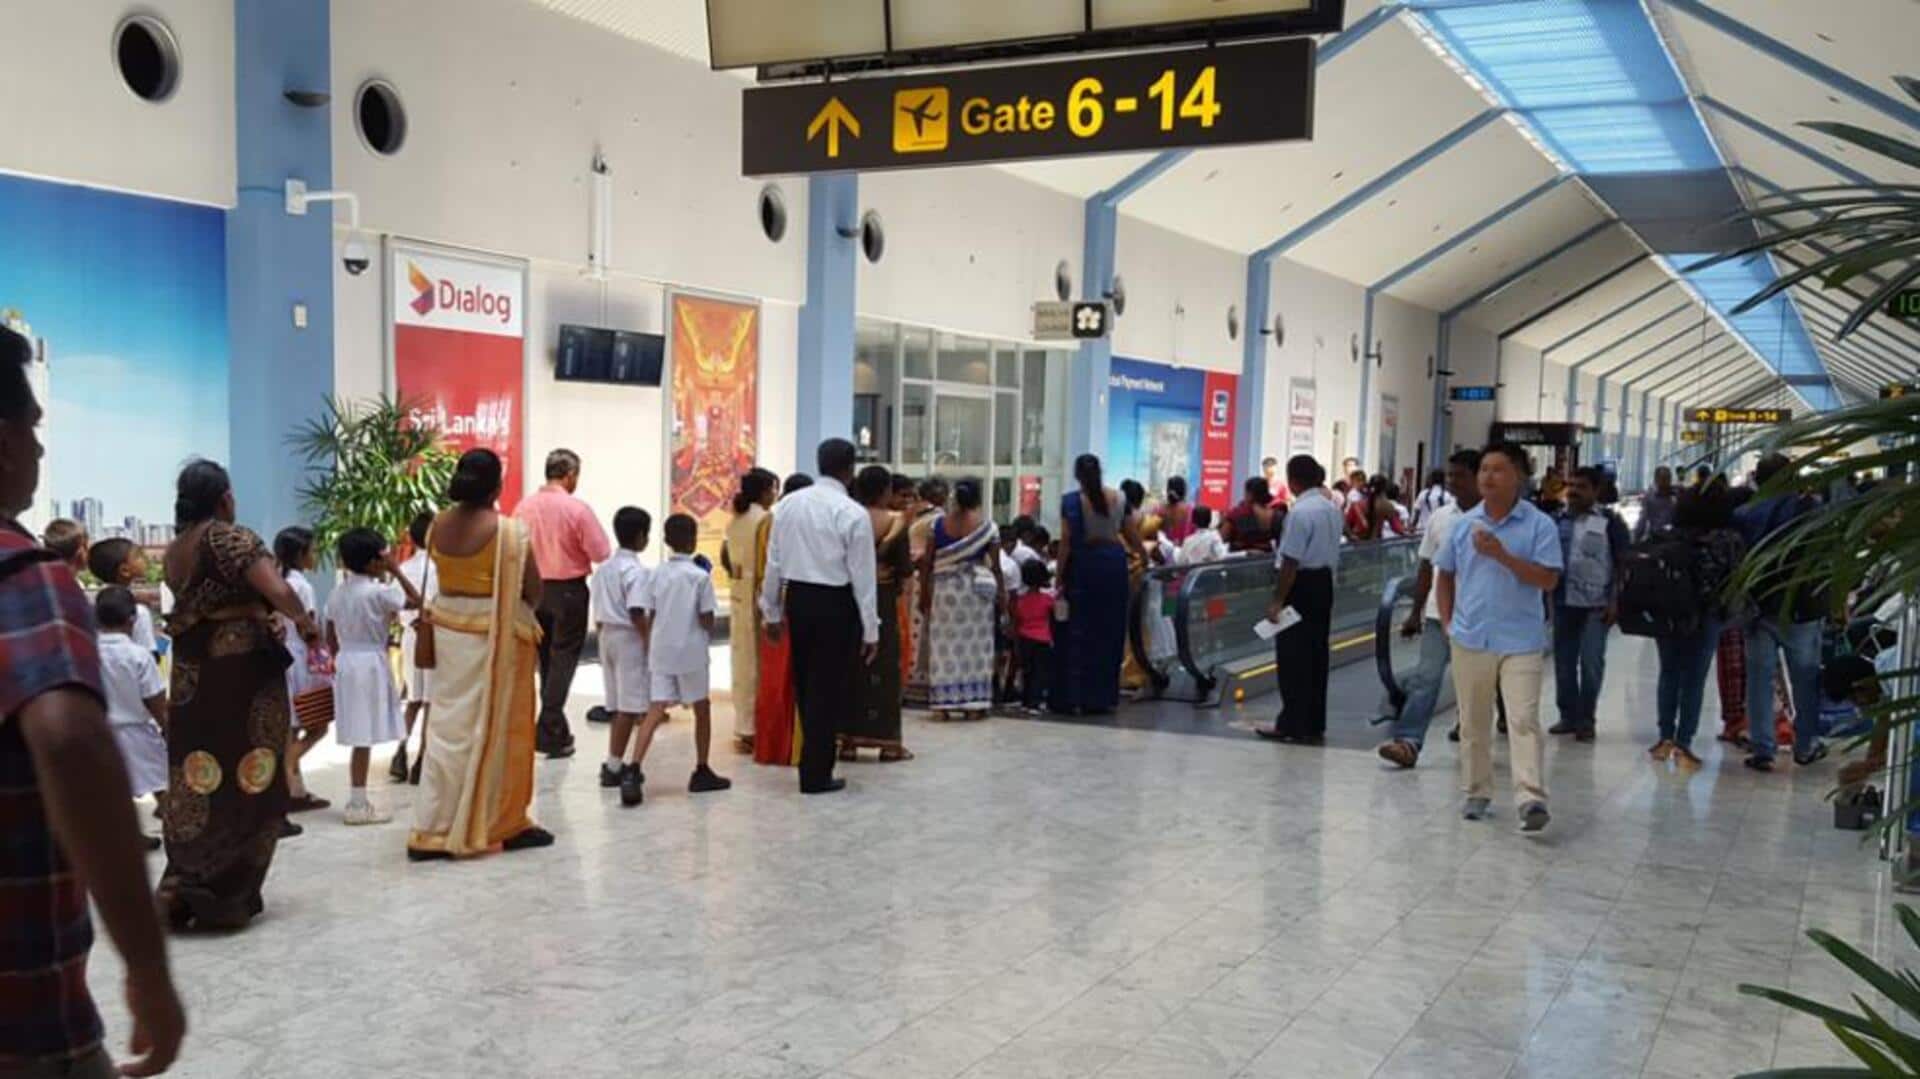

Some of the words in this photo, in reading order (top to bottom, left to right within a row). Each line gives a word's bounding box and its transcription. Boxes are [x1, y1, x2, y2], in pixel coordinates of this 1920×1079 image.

[960, 95, 1056, 135] Gate
[1067, 77, 1104, 138] 6
[1148, 66, 1221, 131] 14
[439, 280, 511, 323] Dialog
